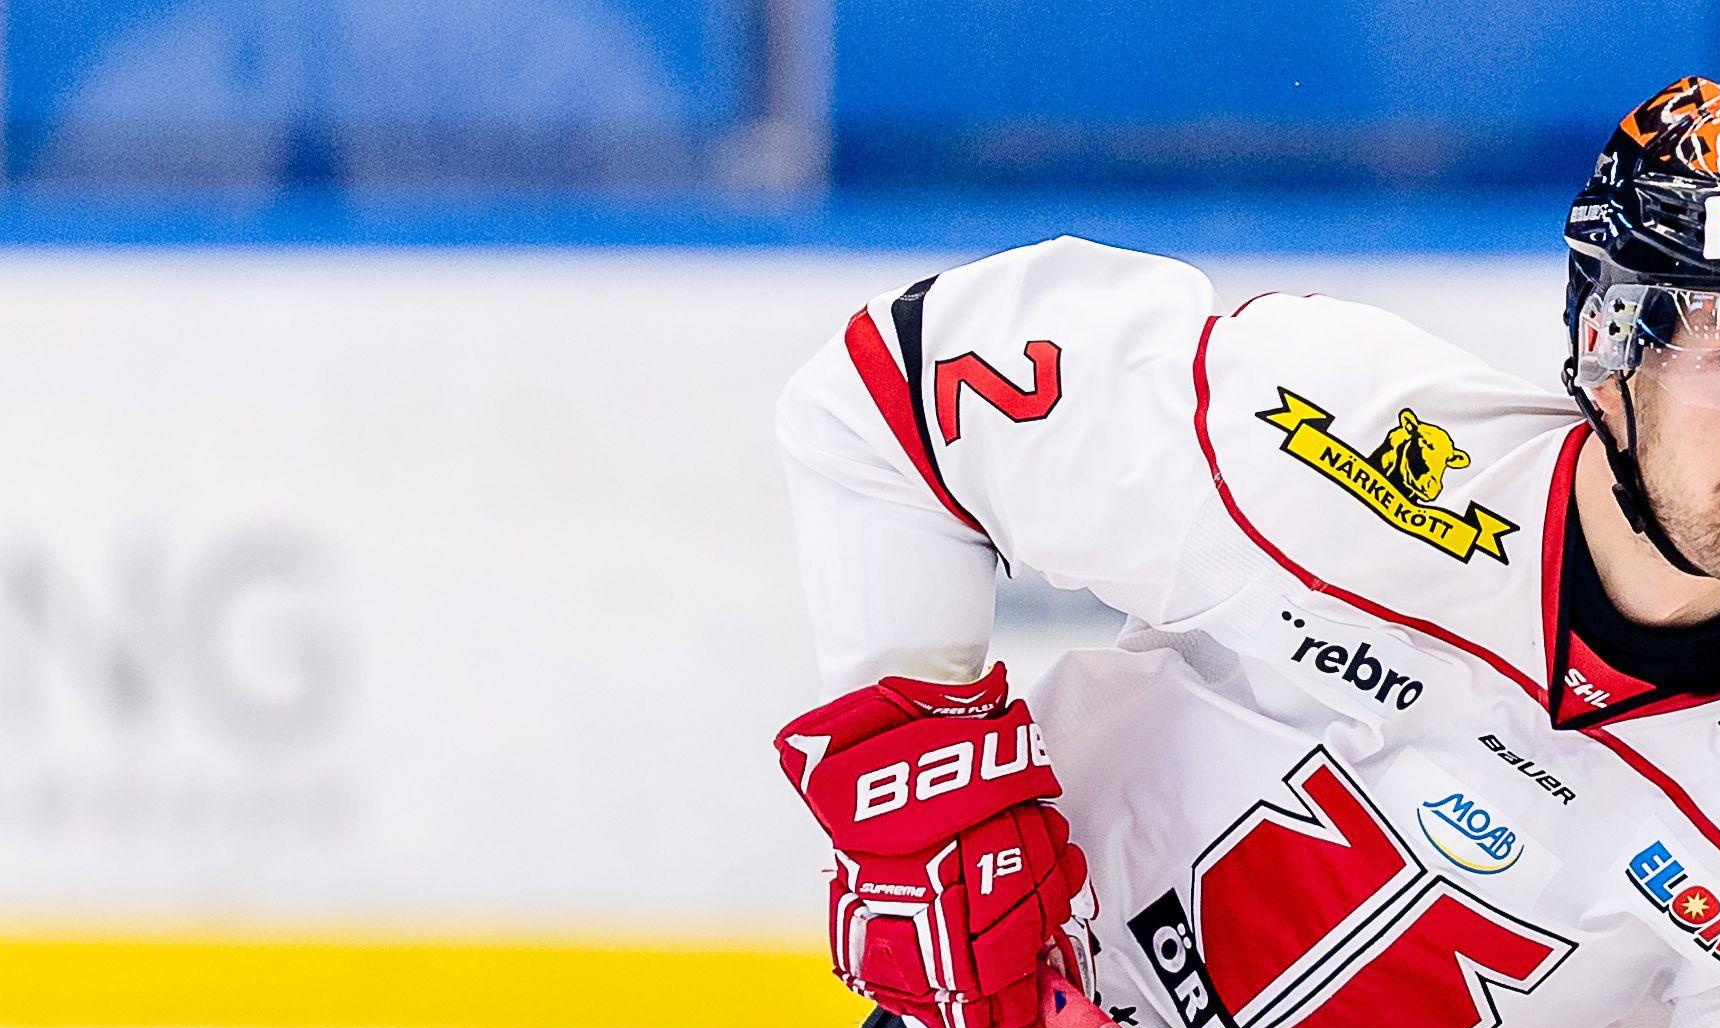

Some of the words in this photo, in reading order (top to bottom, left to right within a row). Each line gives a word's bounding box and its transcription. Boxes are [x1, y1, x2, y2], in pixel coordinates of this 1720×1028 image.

[935, 340, 1063, 447] 2
[1318, 444, 1395, 508] NÄRKE
[1392, 501, 1455, 541] KÖTT
[1564, 667, 1614, 709] SHL
[1477, 733, 1577, 806] BAUER
[1423, 791, 1520, 860] MOAB
[859, 882, 927, 898] SUPREME
[976, 847, 1023, 895] 1S
